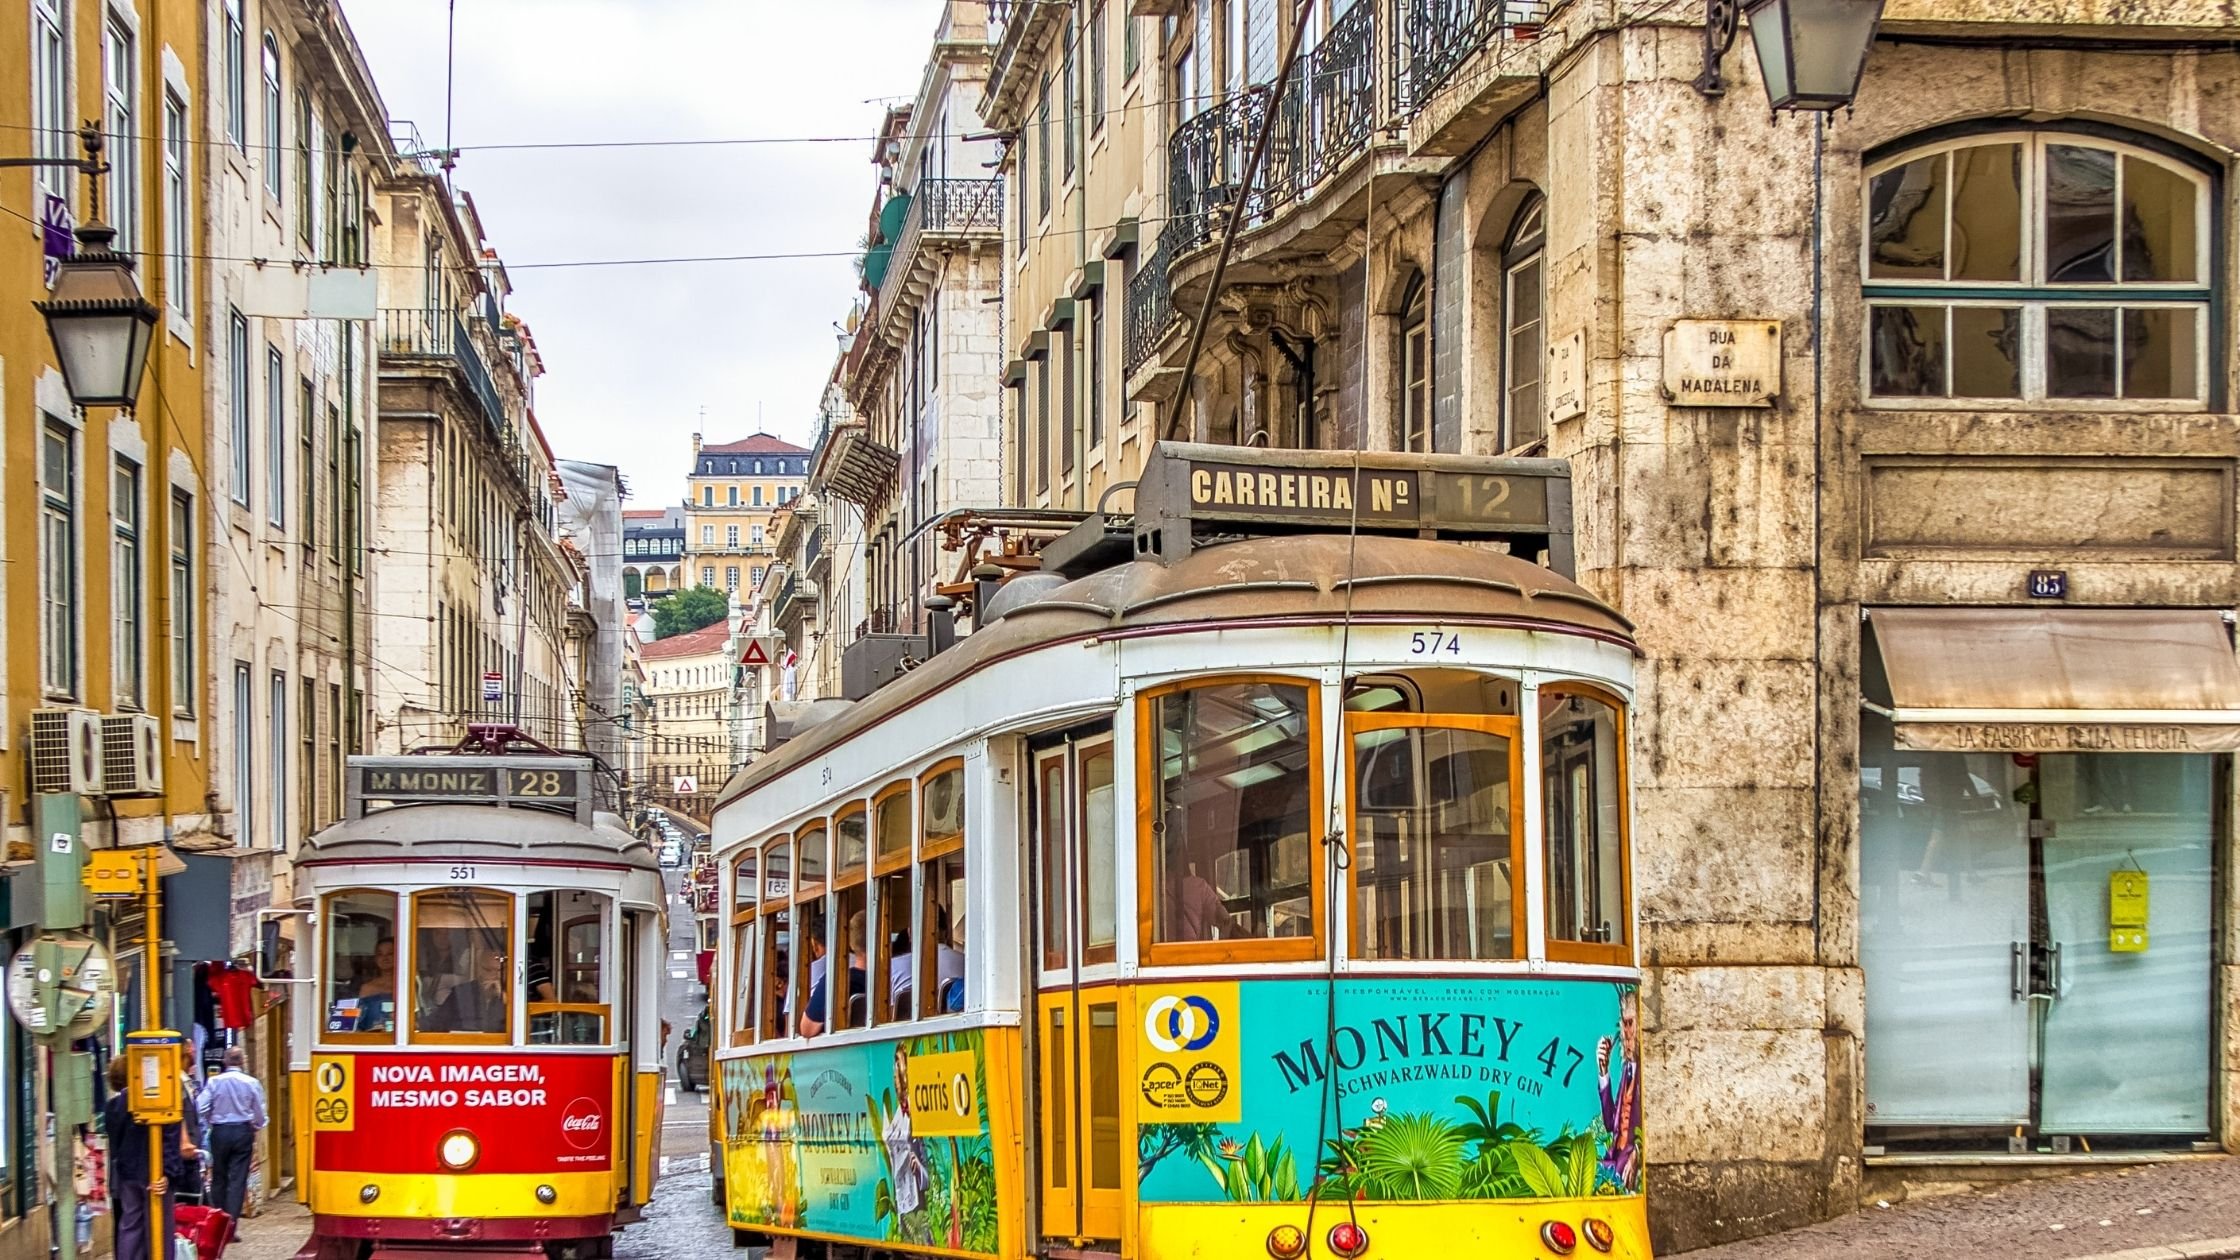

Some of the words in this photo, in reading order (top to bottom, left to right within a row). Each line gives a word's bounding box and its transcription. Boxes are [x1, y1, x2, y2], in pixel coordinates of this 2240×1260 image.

[1709, 331, 1736, 345] RUA
[1712, 355, 1731, 369] DA
[1681, 379, 1762, 394] MADALENA
[1191, 469, 1353, 510] CARREIRA
[1457, 474, 1511, 520] 12
[2036, 574, 2061, 595] 85
[1411, 632, 1461, 655] 574
[370, 772, 396, 791] M.
[400, 772, 486, 791] MONIZ
[449, 866, 476, 880] 551
[1271, 1013, 1523, 1094] MONKEY
[1536, 1036, 1585, 1089] 47
[372, 1065, 435, 1083] NOVA
[440, 1065, 546, 1085] IMAGEM,
[1337, 1063, 1473, 1099] SCHWARZWALD
[1479, 1066, 1513, 1086] DRY
[1517, 1075, 1544, 1098] GIN
[914, 1071, 950, 1113] carris
[1148, 1081, 1176, 1092] apcer
[371, 1089, 459, 1107] MESMO
[464, 1089, 547, 1107] SABOR
[801, 1112, 852, 1154] MONKEY
